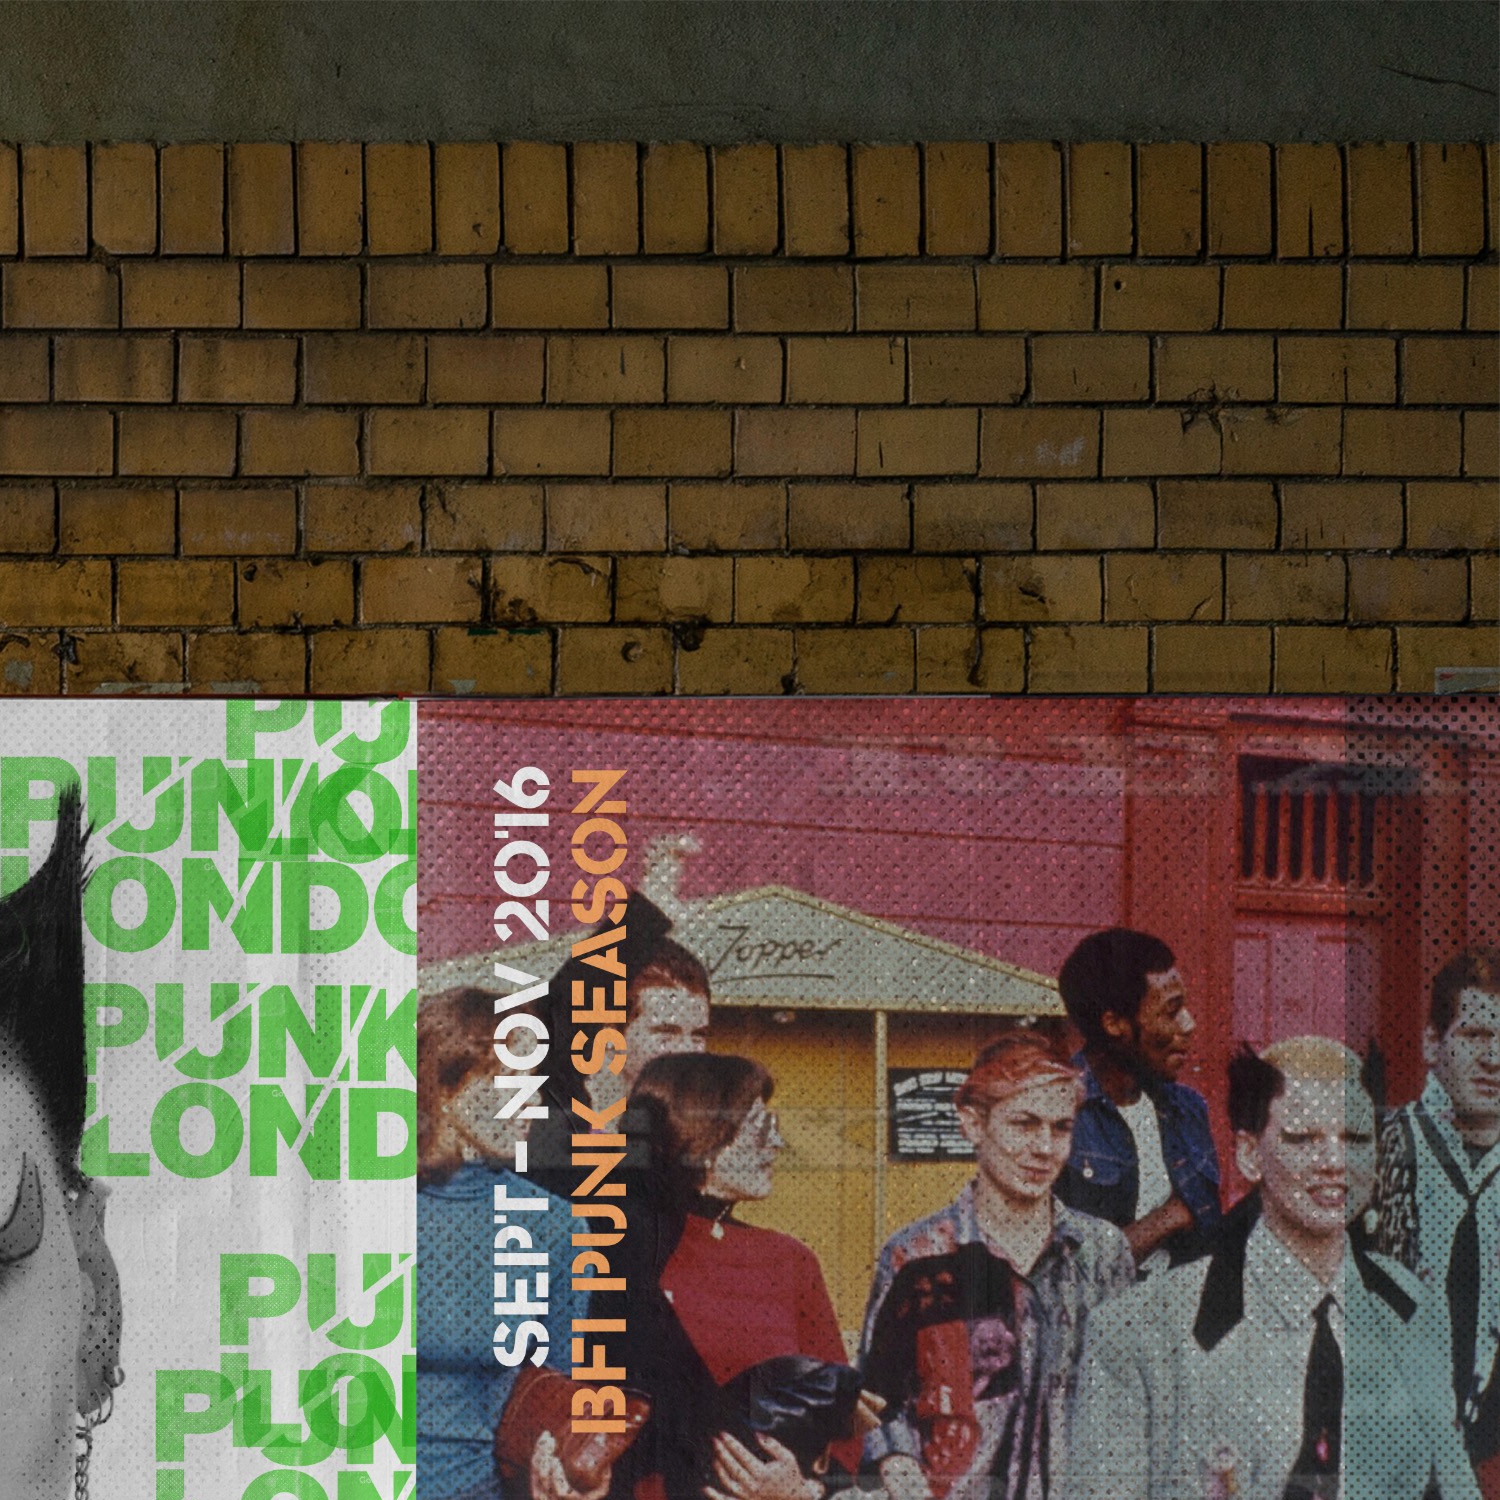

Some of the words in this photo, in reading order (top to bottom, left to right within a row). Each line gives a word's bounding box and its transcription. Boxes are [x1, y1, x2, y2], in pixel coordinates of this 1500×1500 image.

[493, 765, 550, 942] 2016
[570, 769, 628, 1076] SEASON
[493, 962, 550, 1120] NOV
[493, 1184, 550, 1369] SEPT
[571, 1096, 627, 1291] PUNK
[571, 1318, 627, 1434] BFI
